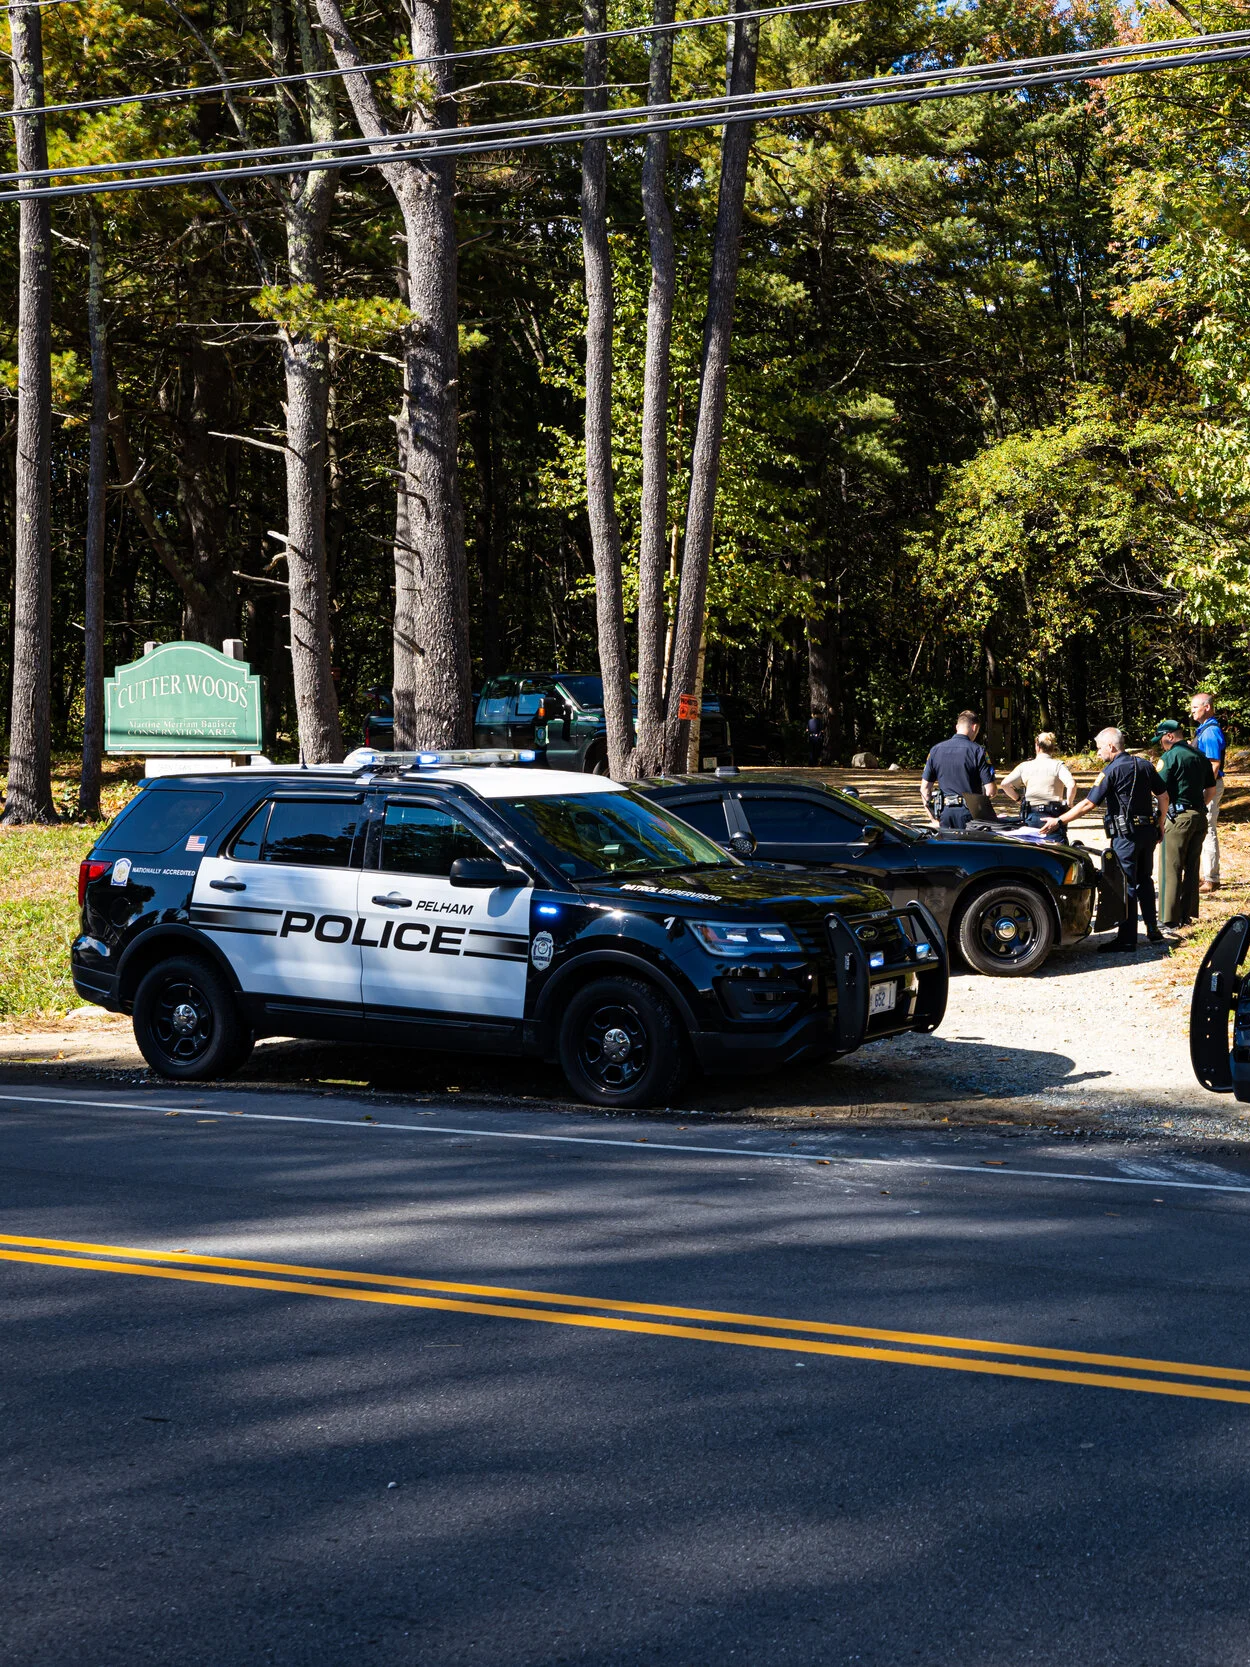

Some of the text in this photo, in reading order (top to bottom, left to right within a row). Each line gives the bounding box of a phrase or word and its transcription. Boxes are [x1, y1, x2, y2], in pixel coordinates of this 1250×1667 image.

[118, 675, 248, 709] CUTTER WOODS
[127, 728, 237, 736] CONSERVATION AREA
[162, 868, 196, 877] ACCREDITED
[620, 884, 722, 902] PATROL SUPERVISOR
[416, 900, 474, 916] PELHAM
[663, 916, 676, 930] 1
[279, 910, 467, 956] POLICE
